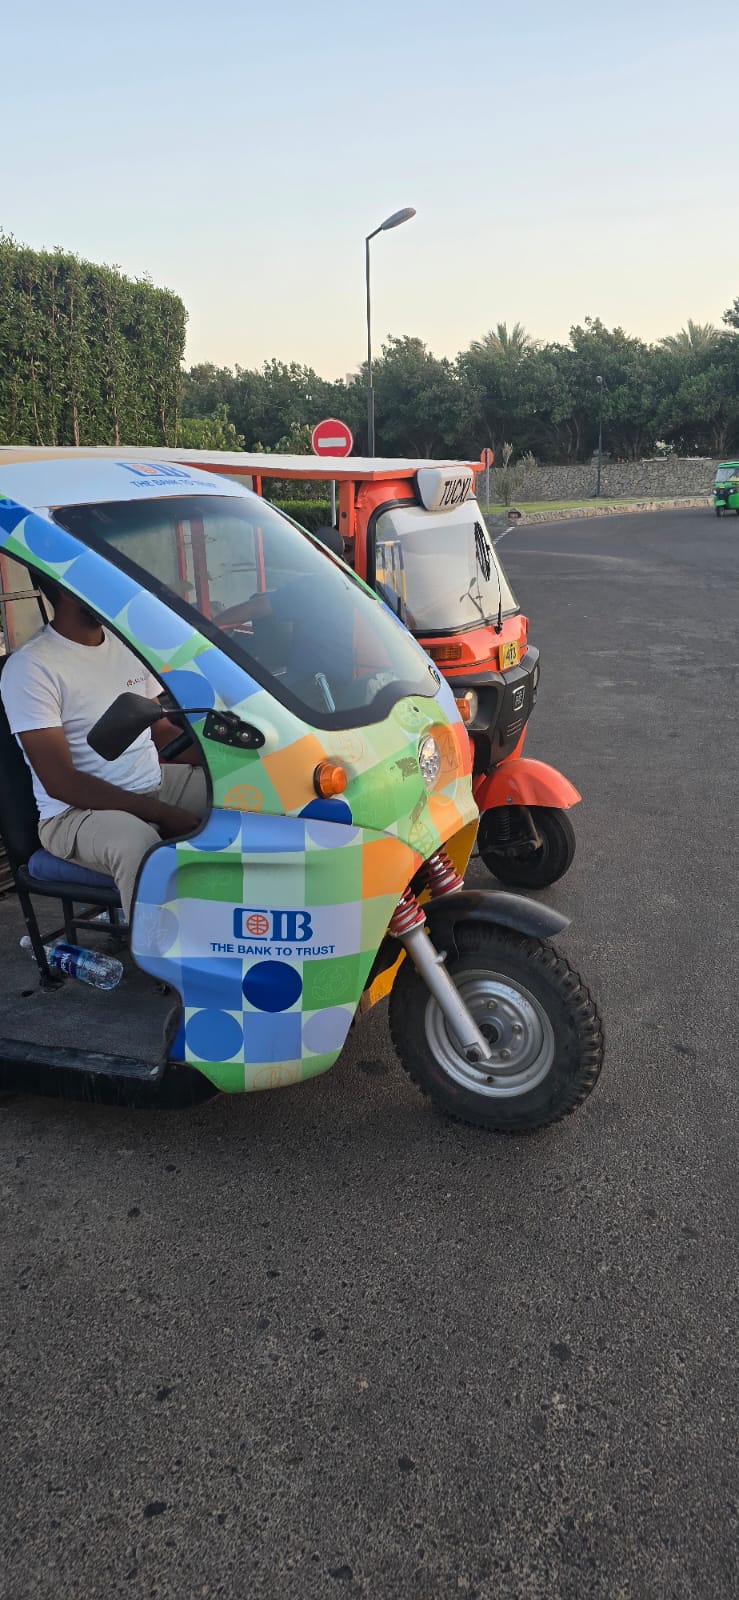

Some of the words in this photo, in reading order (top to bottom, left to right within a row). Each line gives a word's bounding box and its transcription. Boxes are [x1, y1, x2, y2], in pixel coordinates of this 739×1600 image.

[233, 907, 314, 942] CIB
[210, 942, 234, 953] THE
[237, 944, 272, 956] BANK
[275, 947, 293, 956] TO
[296, 945, 335, 956] TRUST
